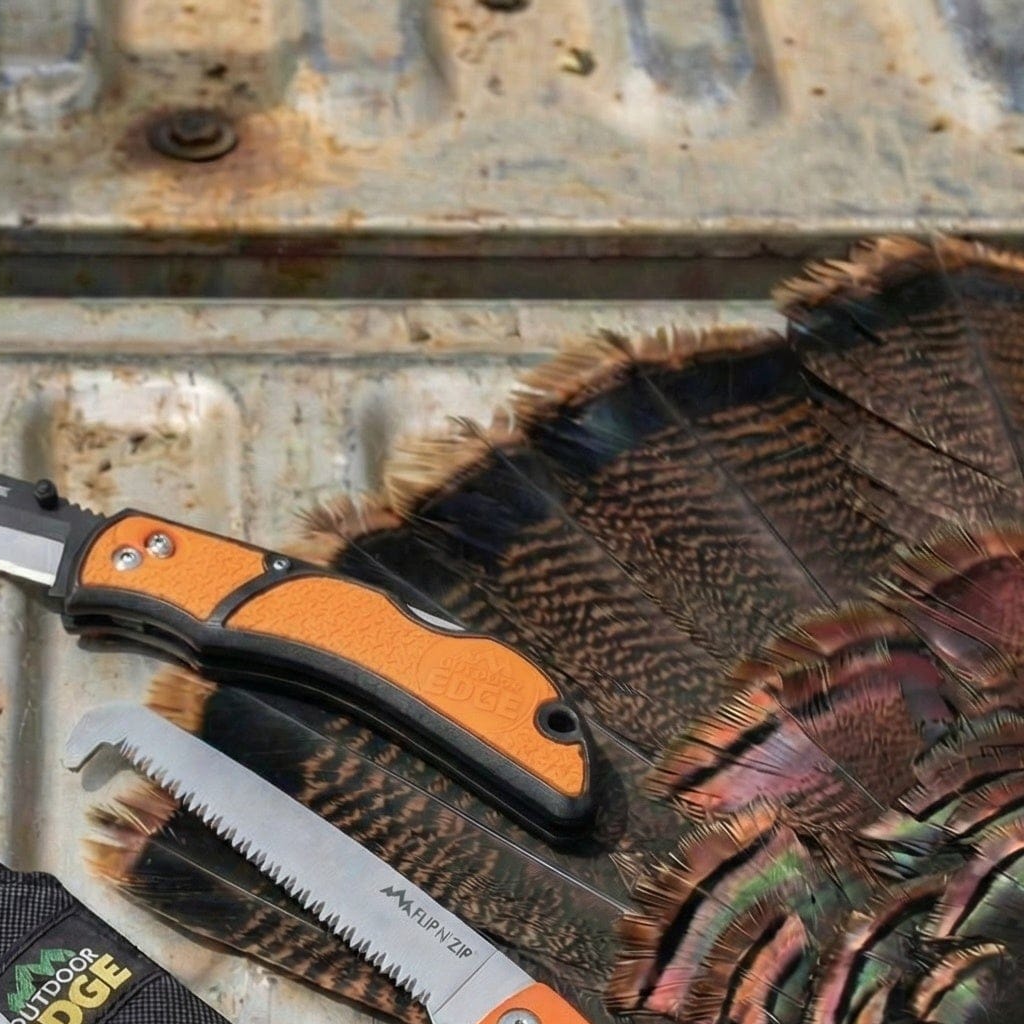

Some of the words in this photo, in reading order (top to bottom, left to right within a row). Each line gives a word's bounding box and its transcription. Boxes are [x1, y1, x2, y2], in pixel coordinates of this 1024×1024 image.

[424, 667, 523, 721] EDGE
[410, 907, 440, 931] FLIP
[447, 937, 473, 959] ZIP
